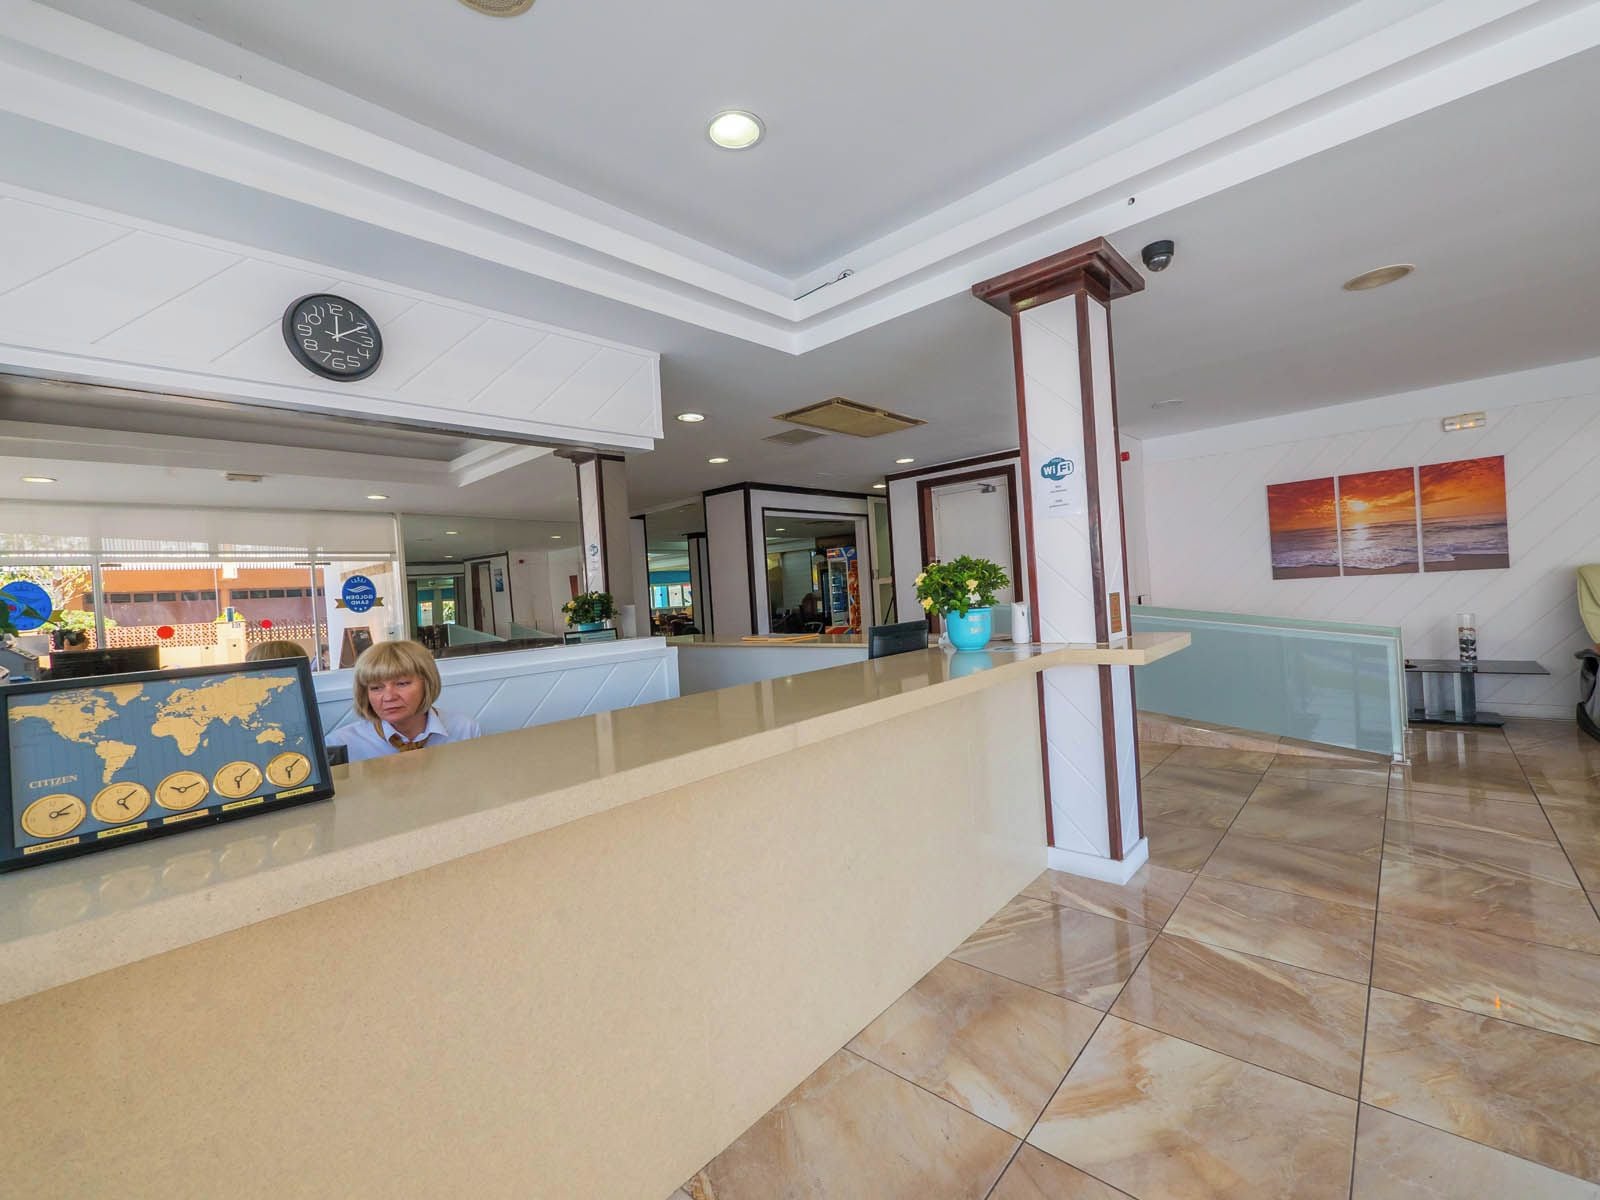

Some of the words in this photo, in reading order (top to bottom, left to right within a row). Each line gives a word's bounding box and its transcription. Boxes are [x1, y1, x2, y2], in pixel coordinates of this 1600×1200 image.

[326, 303, 344, 316] 12
[302, 312, 322, 326] 10
[297, 324, 312, 336] 9
[303, 338, 319, 351] 8
[361, 335, 374, 348] 3
[320, 350, 332, 362] 7
[357, 347, 370, 359] 4
[332, 357, 346, 370] 6
[347, 355, 361, 368] 5
[29, 774, 79, 789] CITIZEN
